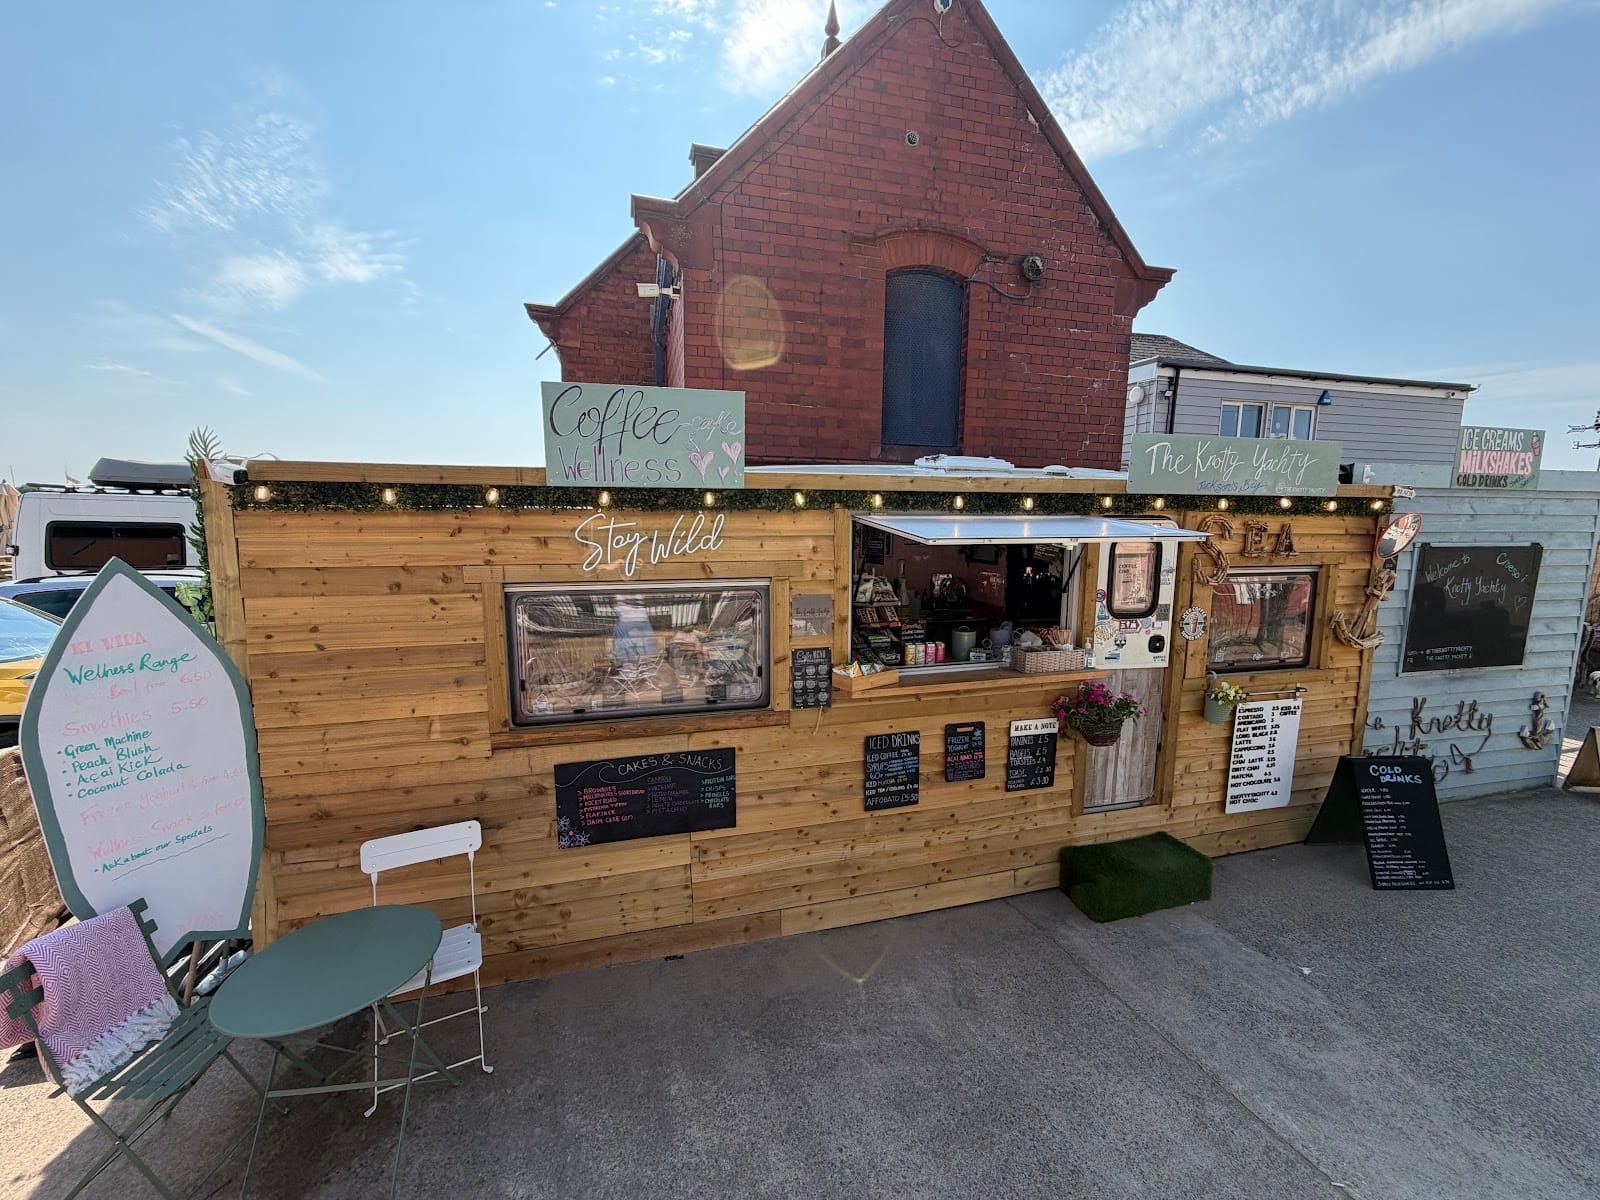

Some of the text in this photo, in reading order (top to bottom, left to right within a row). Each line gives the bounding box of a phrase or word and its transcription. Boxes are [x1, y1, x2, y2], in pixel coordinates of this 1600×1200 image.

[550, 385, 684, 455] Coffee
[1462, 428, 1524, 451] ICE CREAMS
[558, 444, 683, 483] Wellness
[1145, 441, 1319, 485] The Knotty Yachty
[1457, 474, 1479, 488] COLD
[1480, 475, 1508, 488] DRINKS
[575, 513, 725, 577] Stay Wild
[1191, 514, 1299, 585] SEA
[1425, 553, 1471, 583] Welcome to
[1496, 552, 1520, 579] Croeso
[1444, 575, 1507, 606] Knotty Yachty
[71, 631, 148, 655] KI VIDA
[63, 652, 198, 685] Wellness Range
[63, 710, 152, 737] Smoothies
[1014, 723, 1032, 732] MAKE
[1040, 721, 1057, 730] NOTE
[64, 730, 153, 759] Green Machine
[869, 733, 920, 749] ICED DRINKS
[1010, 735, 1049, 747] PANINIS £5
[1010, 748, 1031, 758] BAGELS
[1036, 747, 1048, 756] £5
[72, 743, 160, 774] Peach Blush
[617, 753, 722, 776] CAKES & SNACKS
[866, 762, 889, 772] SYRUPS
[867, 754, 879, 762] ICED
[880, 751, 898, 760] COFFEE
[77, 763, 192, 799] Coconut Colada
[1369, 764, 1402, 776] COLD
[583, 786, 617, 795] BROWNIES
[866, 780, 877, 788] ICED
[1243, 779, 1272, 787] CHOCOLATE
[705, 791, 730, 799] PRINGLES
[866, 795, 899, 806] AFFOGATO
[155, 840, 172, 852] our
[175, 825, 214, 845] Specials
